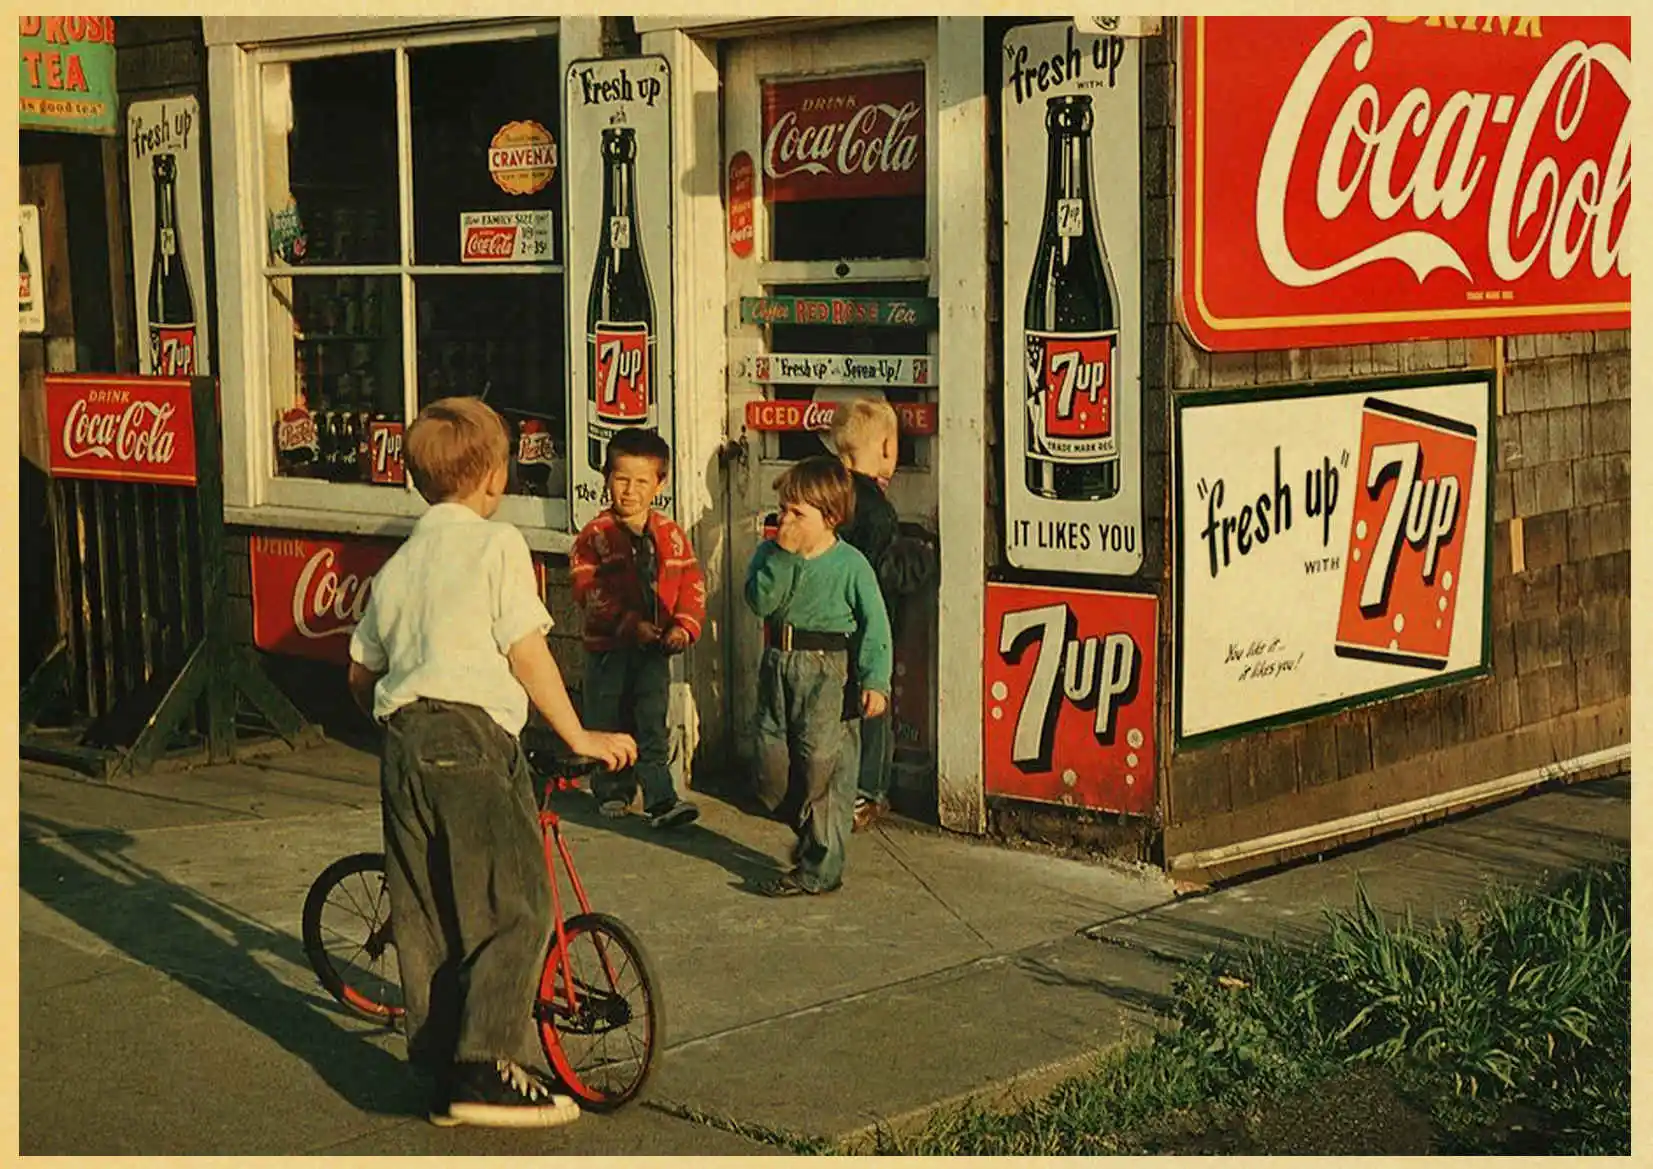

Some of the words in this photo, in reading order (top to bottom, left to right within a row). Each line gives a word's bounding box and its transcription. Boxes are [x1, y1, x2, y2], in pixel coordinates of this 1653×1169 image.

[22, 52, 90, 92] TEA
[1076, 80, 1104, 89] WITH
[40, 100, 73, 115] good
[802, 96, 857, 111] DRINK
[1256, 16, 1631, 287] Coca-Col
[796, 299, 830, 324] RED
[832, 299, 880, 324] ROSE
[886, 302, 918, 325] Tea
[163, 338, 191, 376] 7up
[601, 340, 642, 404] 7up
[1052, 351, 1106, 418] 7up
[88, 390, 130, 404] DRINK
[755, 406, 799, 426] ICED
[902, 408, 928, 428] RE
[374, 427, 402, 472] 7up
[1047, 441, 1072, 452] TRADE
[1074, 442, 1096, 452] MARK
[575, 483, 597, 502] The
[1014, 520, 1031, 547] IT
[1038, 520, 1091, 551] LIKES
[1098, 523, 1136, 553] YOU
[1360, 440, 1461, 620] 7up
[1304, 557, 1341, 576] WITH
[1224, 643, 1244, 664] You
[1246, 639, 1267, 659] like
[1238, 664, 1252, 682] it
[1250, 660, 1276, 679] likes
[1000, 603, 1141, 772] 7up
